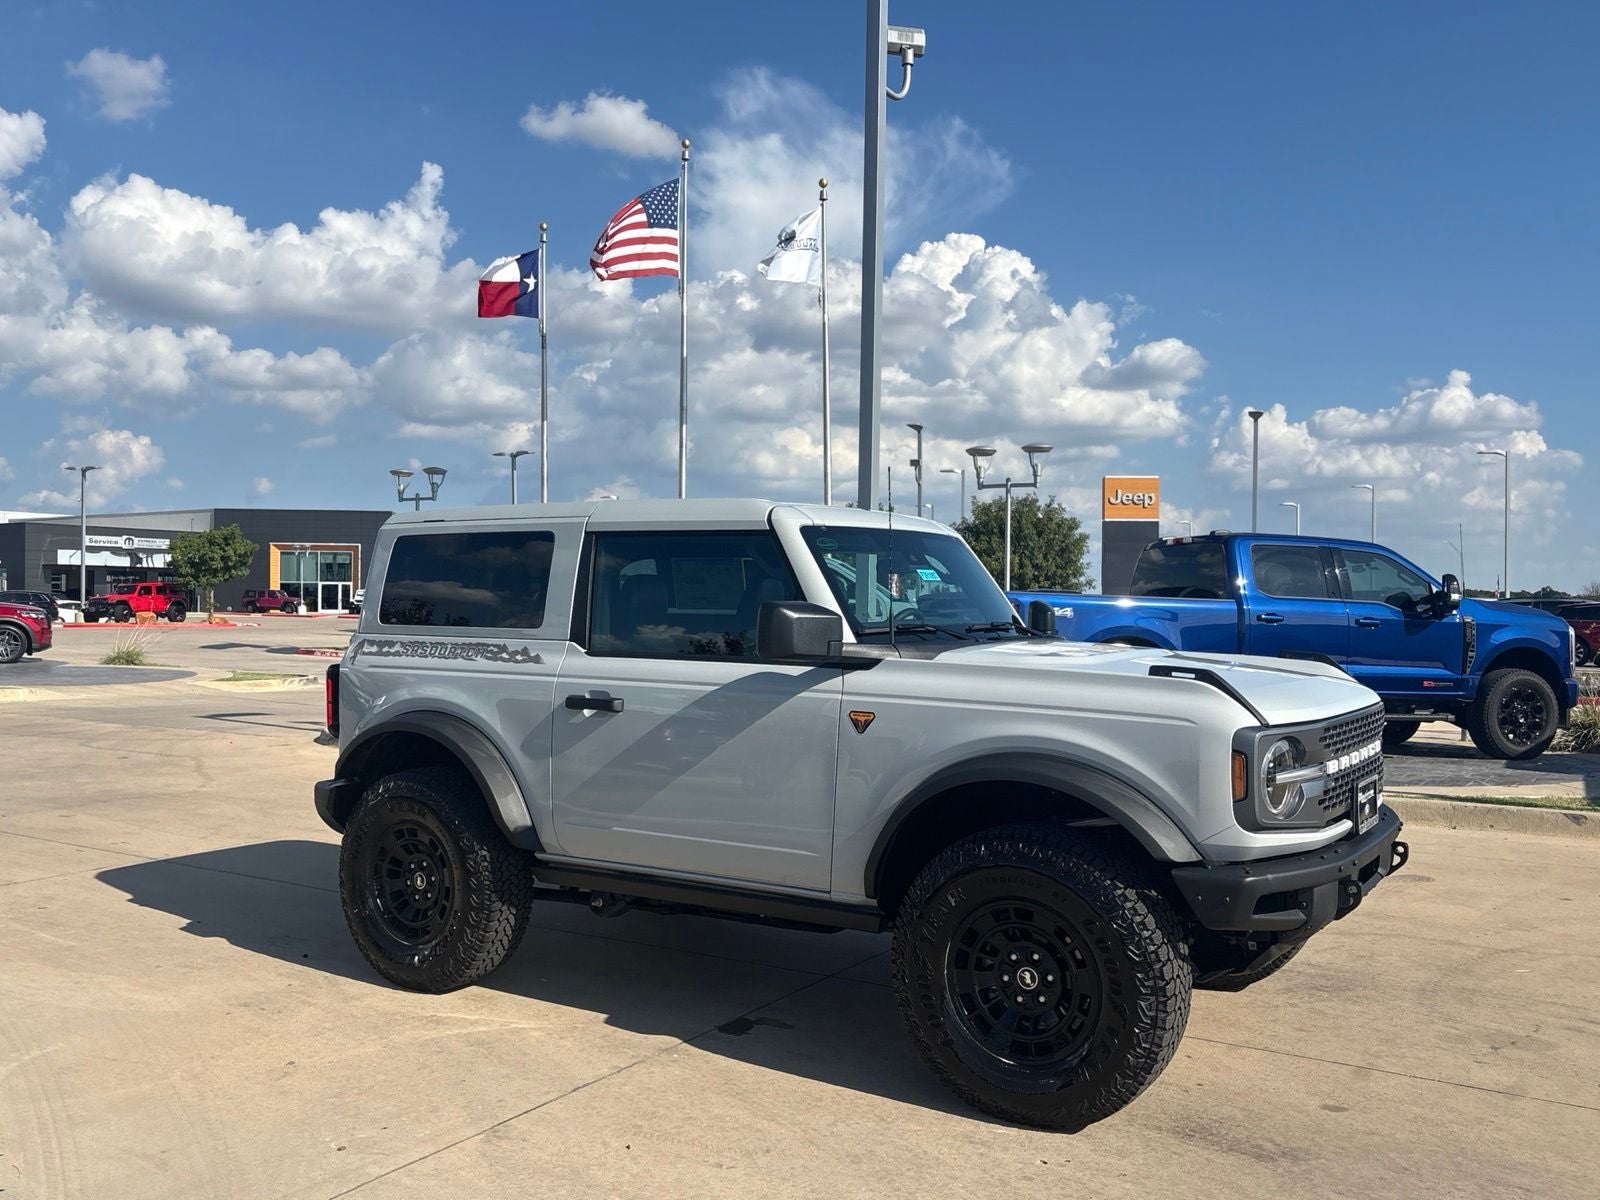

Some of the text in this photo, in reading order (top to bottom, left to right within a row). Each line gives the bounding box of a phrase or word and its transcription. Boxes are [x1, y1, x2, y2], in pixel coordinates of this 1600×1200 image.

[1107, 489, 1156, 509] Jeep
[88, 537, 119, 545] Service
[401, 643, 487, 659] SASQUATCH
[1326, 740, 1382, 774] BRONCO
